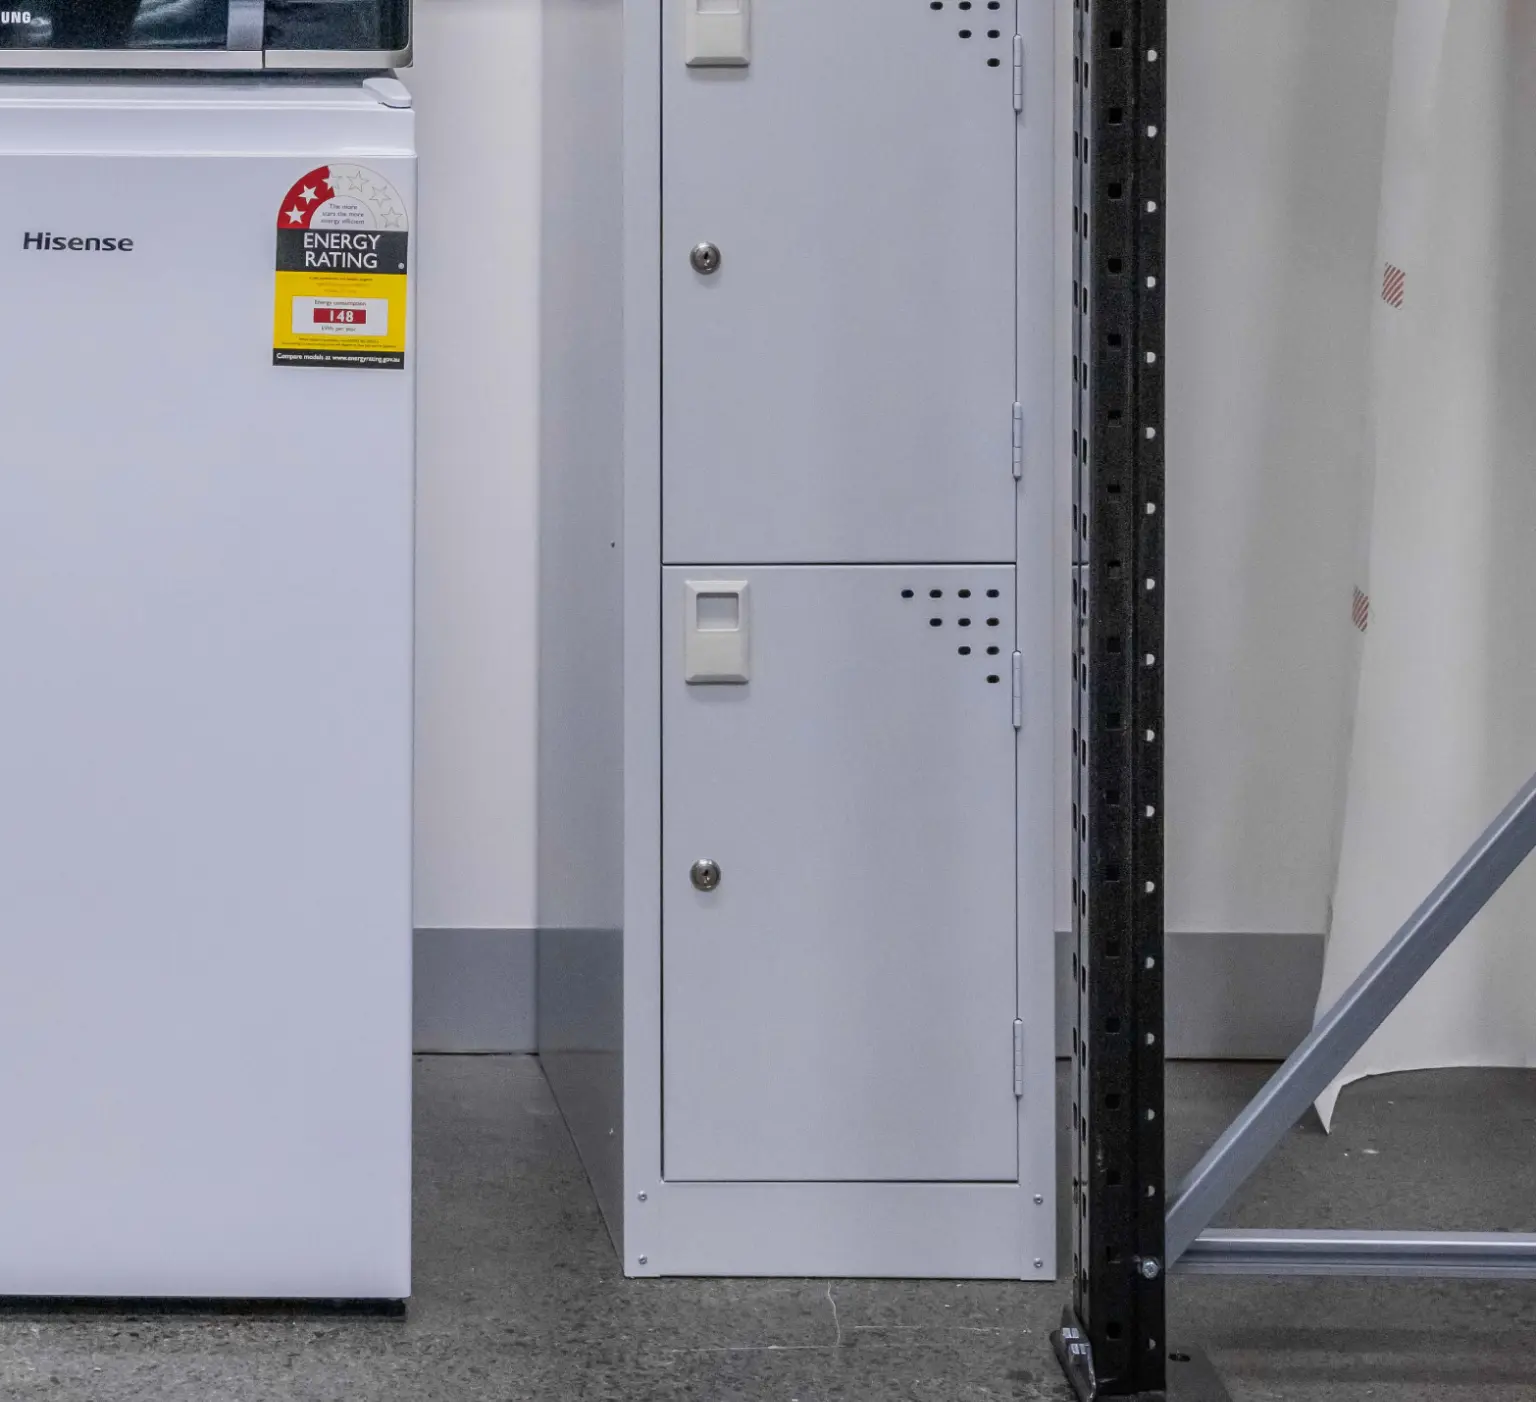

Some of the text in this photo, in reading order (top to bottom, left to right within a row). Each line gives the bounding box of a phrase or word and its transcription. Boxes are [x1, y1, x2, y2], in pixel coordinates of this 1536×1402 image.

[23, 231, 134, 251] Hisense
[304, 232, 381, 250] ENERGY
[305, 250, 378, 269] RATING
[329, 310, 354, 323] 148
[276, 352, 303, 362] Compare
[303, 353, 324, 361] models
